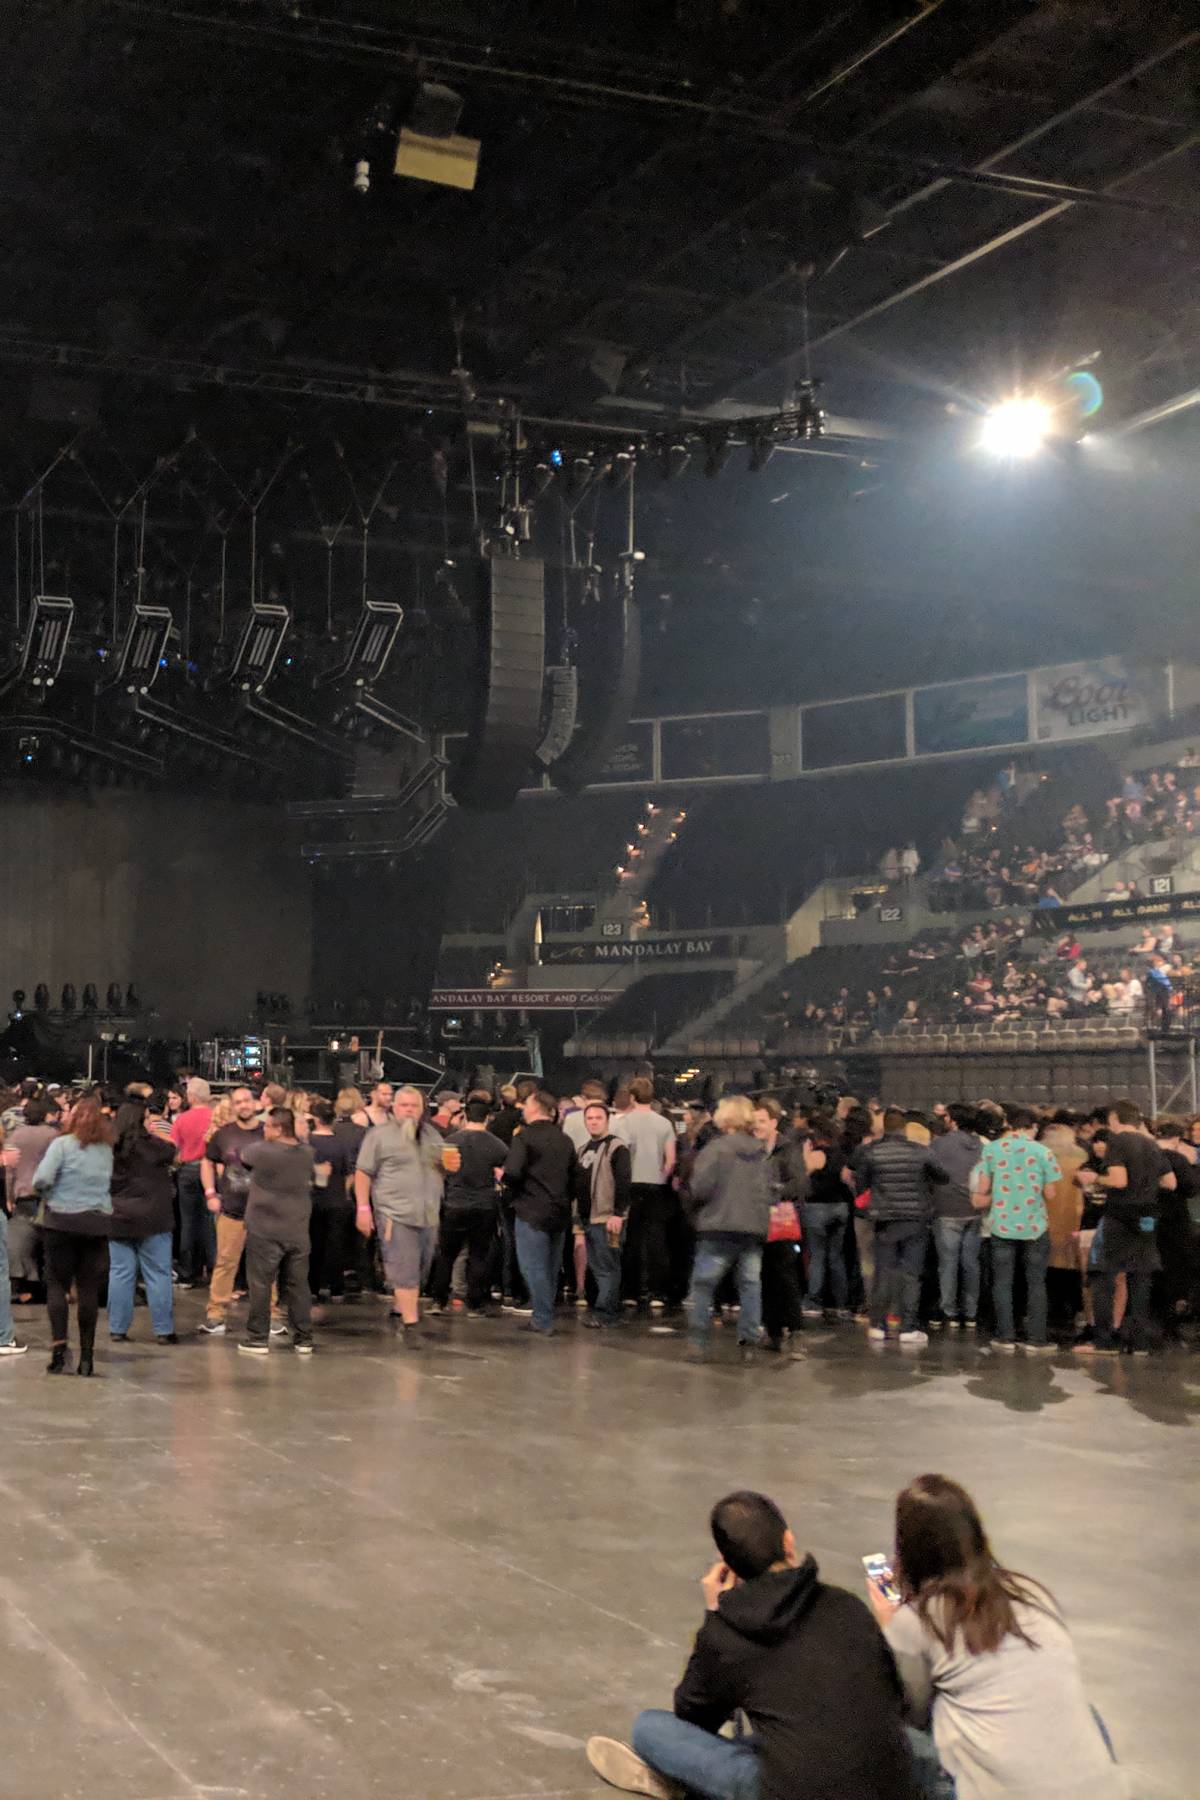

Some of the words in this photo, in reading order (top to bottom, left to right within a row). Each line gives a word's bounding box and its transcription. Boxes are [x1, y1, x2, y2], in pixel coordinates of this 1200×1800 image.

[1154, 878, 1171, 893] 121
[880, 908, 901, 922] 122
[603, 923, 622, 937] 123
[593, 942, 681, 958] MANDALAY
[686, 940, 713, 954] BAY
[486, 994, 506, 1004] BAY
[511, 994, 551, 1004] RESORT
[554, 994, 577, 1004] AND
